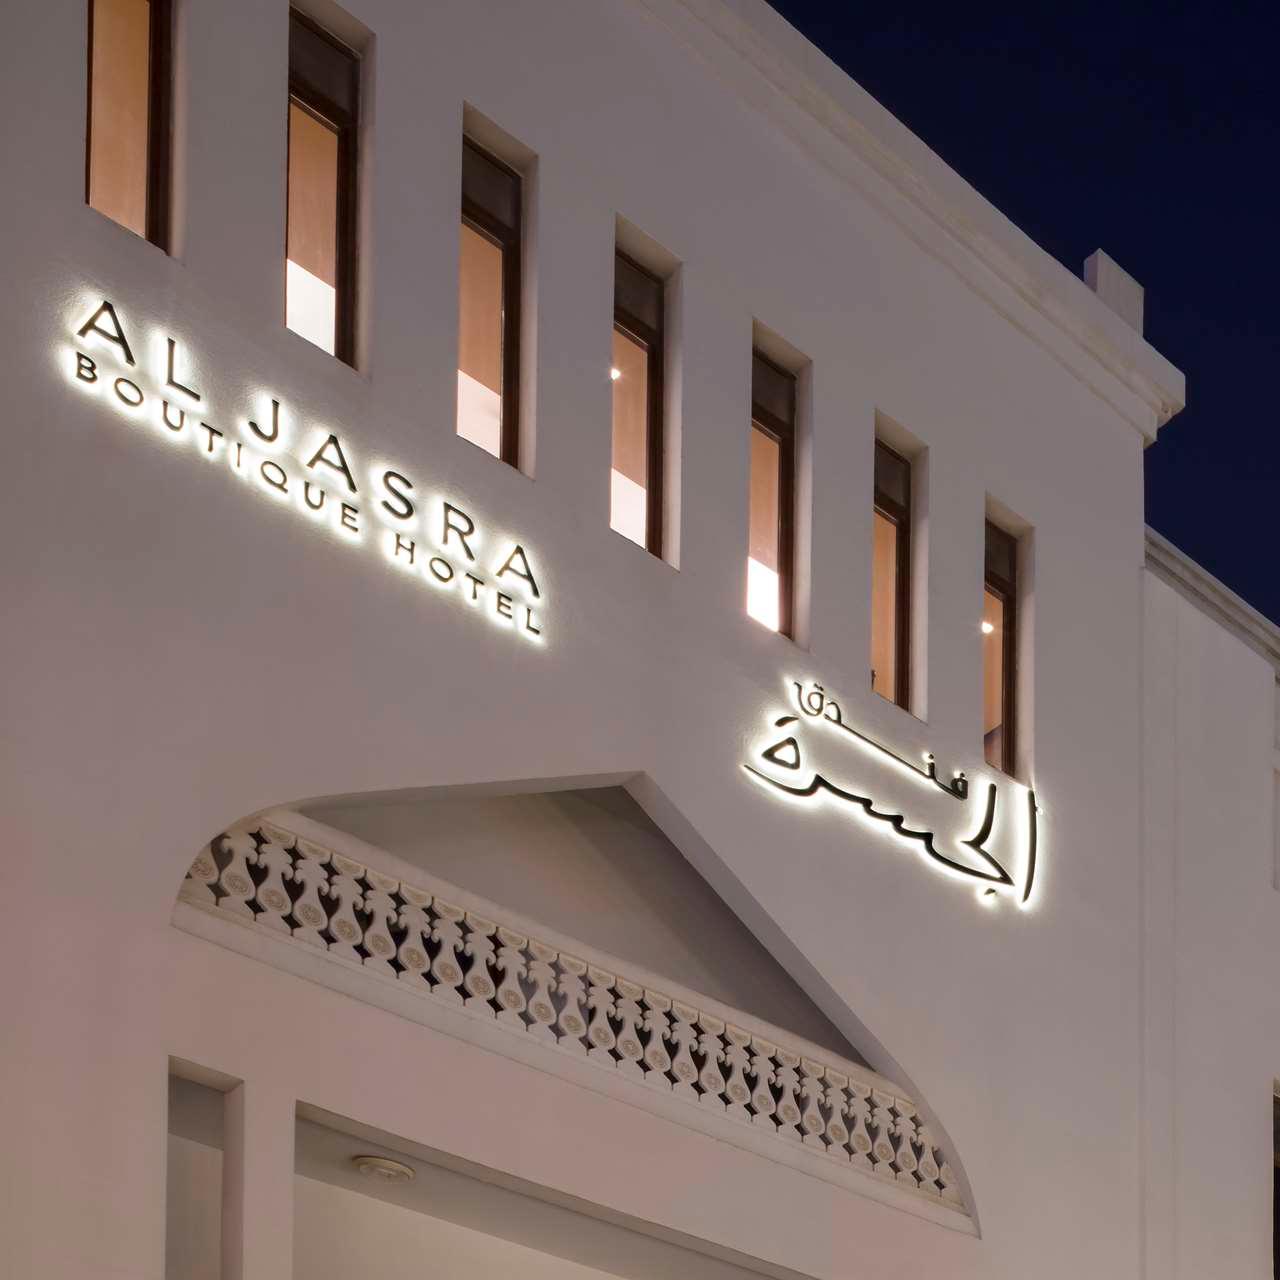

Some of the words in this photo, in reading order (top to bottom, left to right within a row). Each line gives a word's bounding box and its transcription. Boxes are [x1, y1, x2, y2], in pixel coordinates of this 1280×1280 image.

[75, 351, 360, 533] BOUTIQUE
[394, 533, 541, 635] HOTEL
[77, 300, 201, 402] AL
[248, 398, 540, 599] JASRA
[743, 716, 1037, 903] الجسرة
